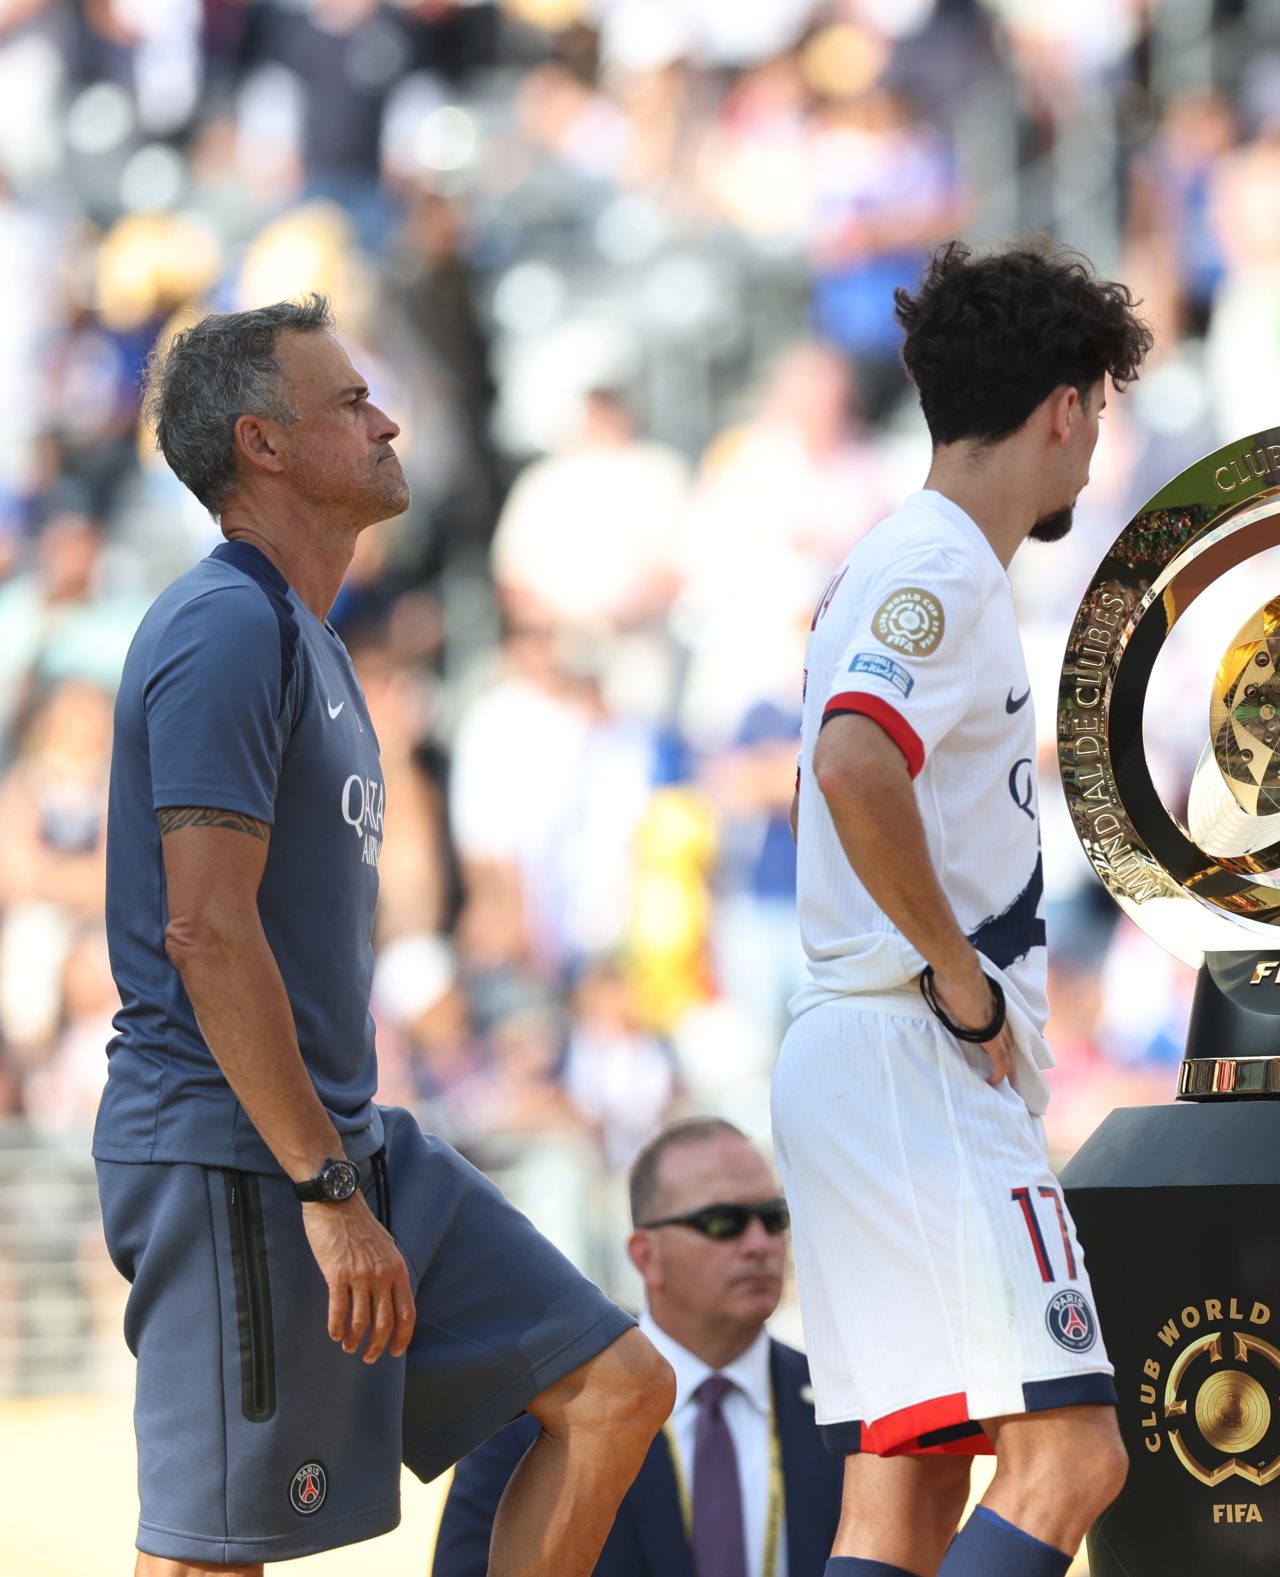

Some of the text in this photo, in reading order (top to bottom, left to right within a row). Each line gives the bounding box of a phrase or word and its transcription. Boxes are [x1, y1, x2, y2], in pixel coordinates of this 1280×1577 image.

[886, 593, 921, 611] WORLD
[923, 599, 939, 617] CUP
[886, 635, 914, 653] FIFA
[1073, 593, 1161, 906] MUNDIAL DE CLUBES
[342, 774, 384, 839] QATA
[1010, 1185, 1077, 1283] 17
[1052, 1294, 1085, 1312] PARIS
[1140, 1358, 1162, 1453] CLUB
[1157, 1298, 1271, 1347] WORLD
[297, 1466, 320, 1482] PARIS
[1213, 1503, 1263, 1523] FIFA
